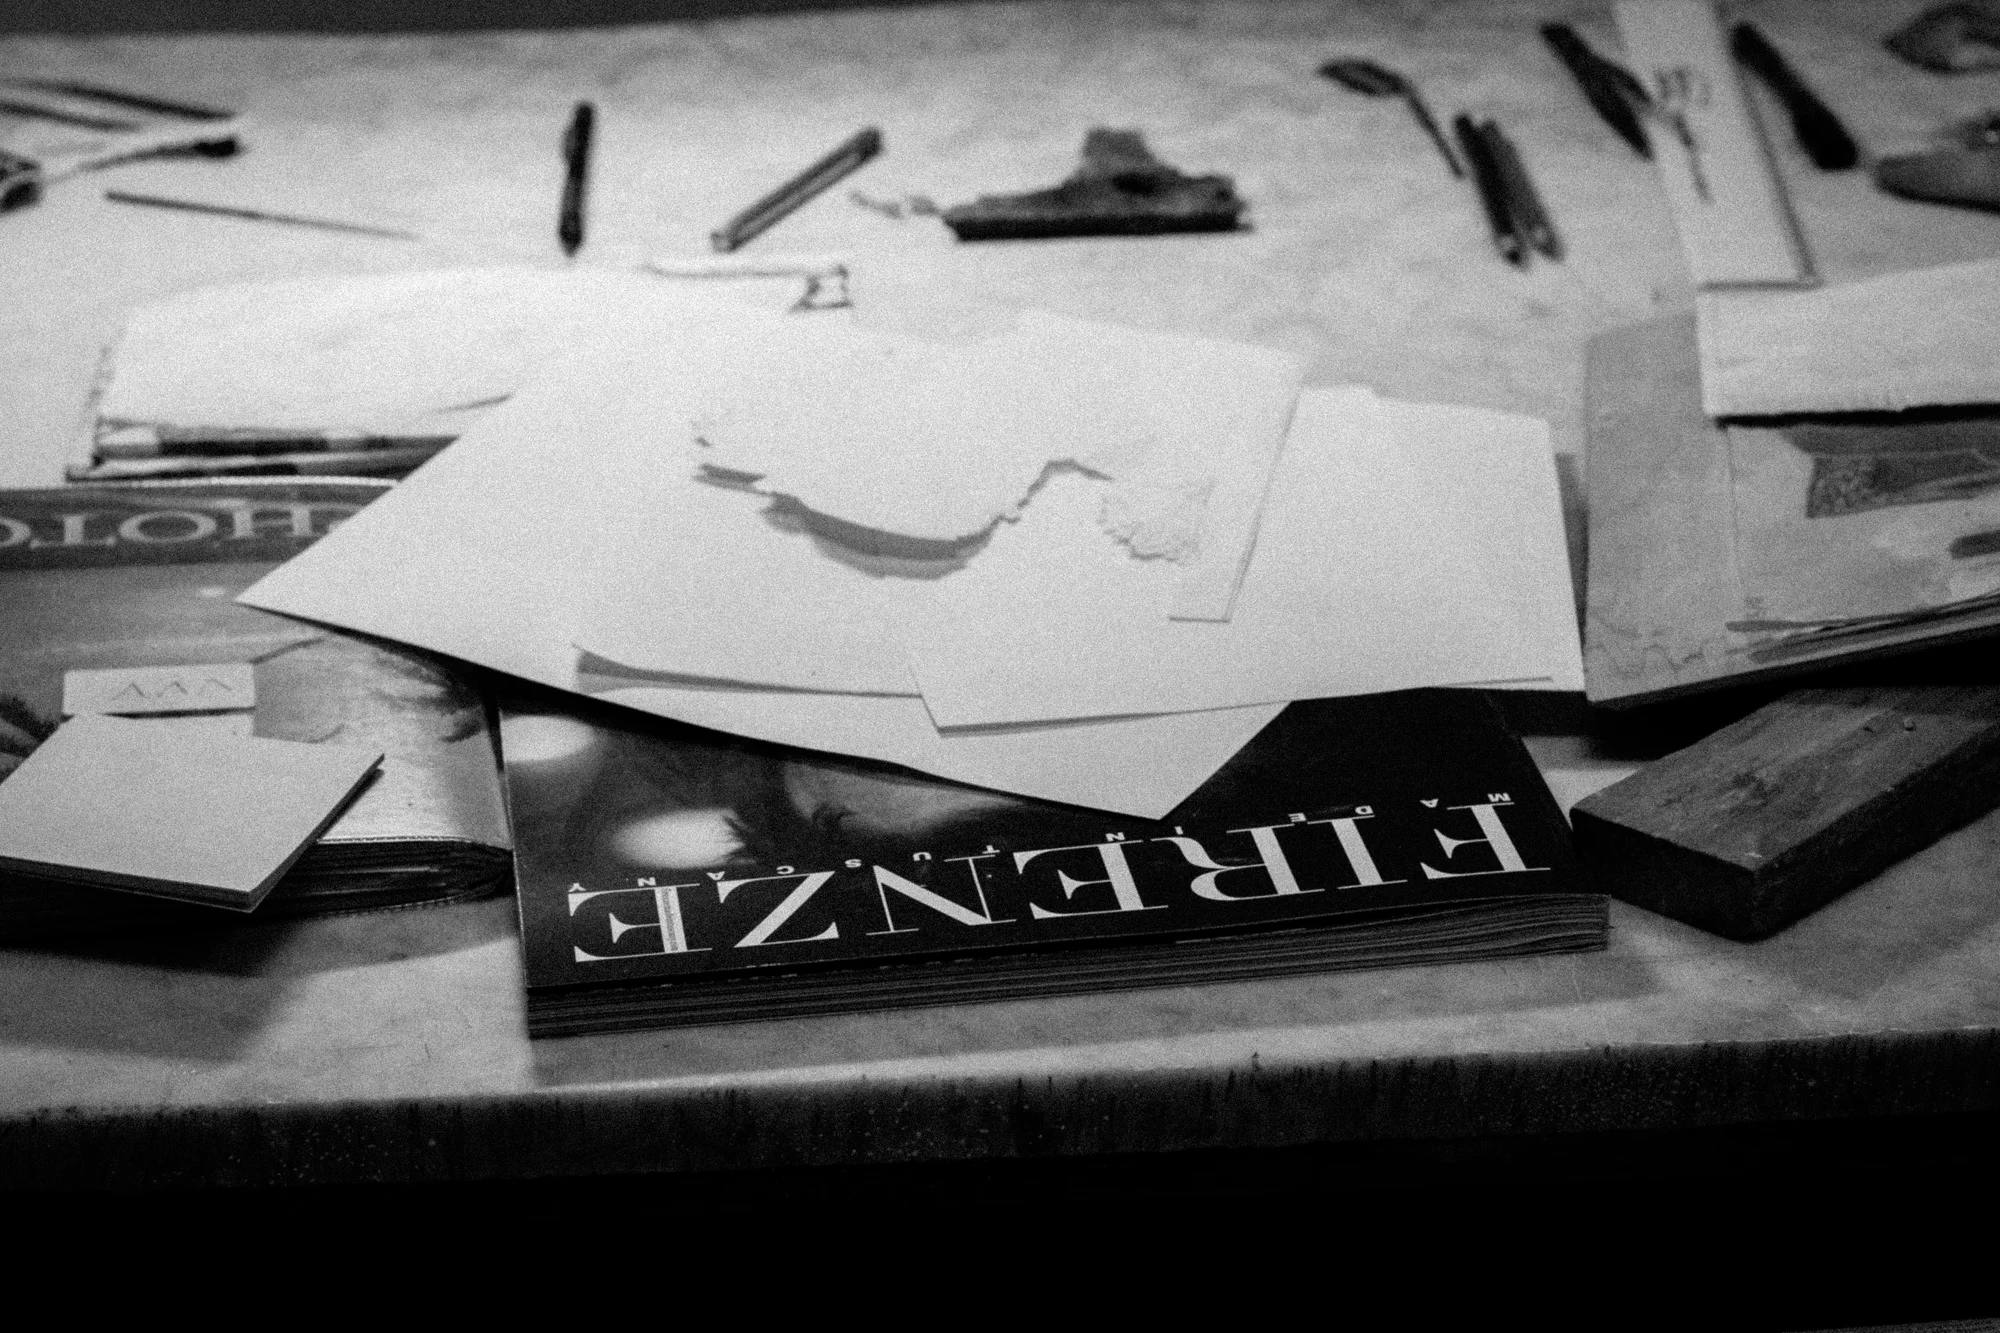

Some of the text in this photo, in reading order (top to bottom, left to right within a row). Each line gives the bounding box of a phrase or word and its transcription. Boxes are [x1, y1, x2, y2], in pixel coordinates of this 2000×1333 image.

[0, 504, 350, 548] HOT
[568, 792, 1512, 893] MADE IN TUSCANY
[568, 802, 1551, 962] FIRENZE
